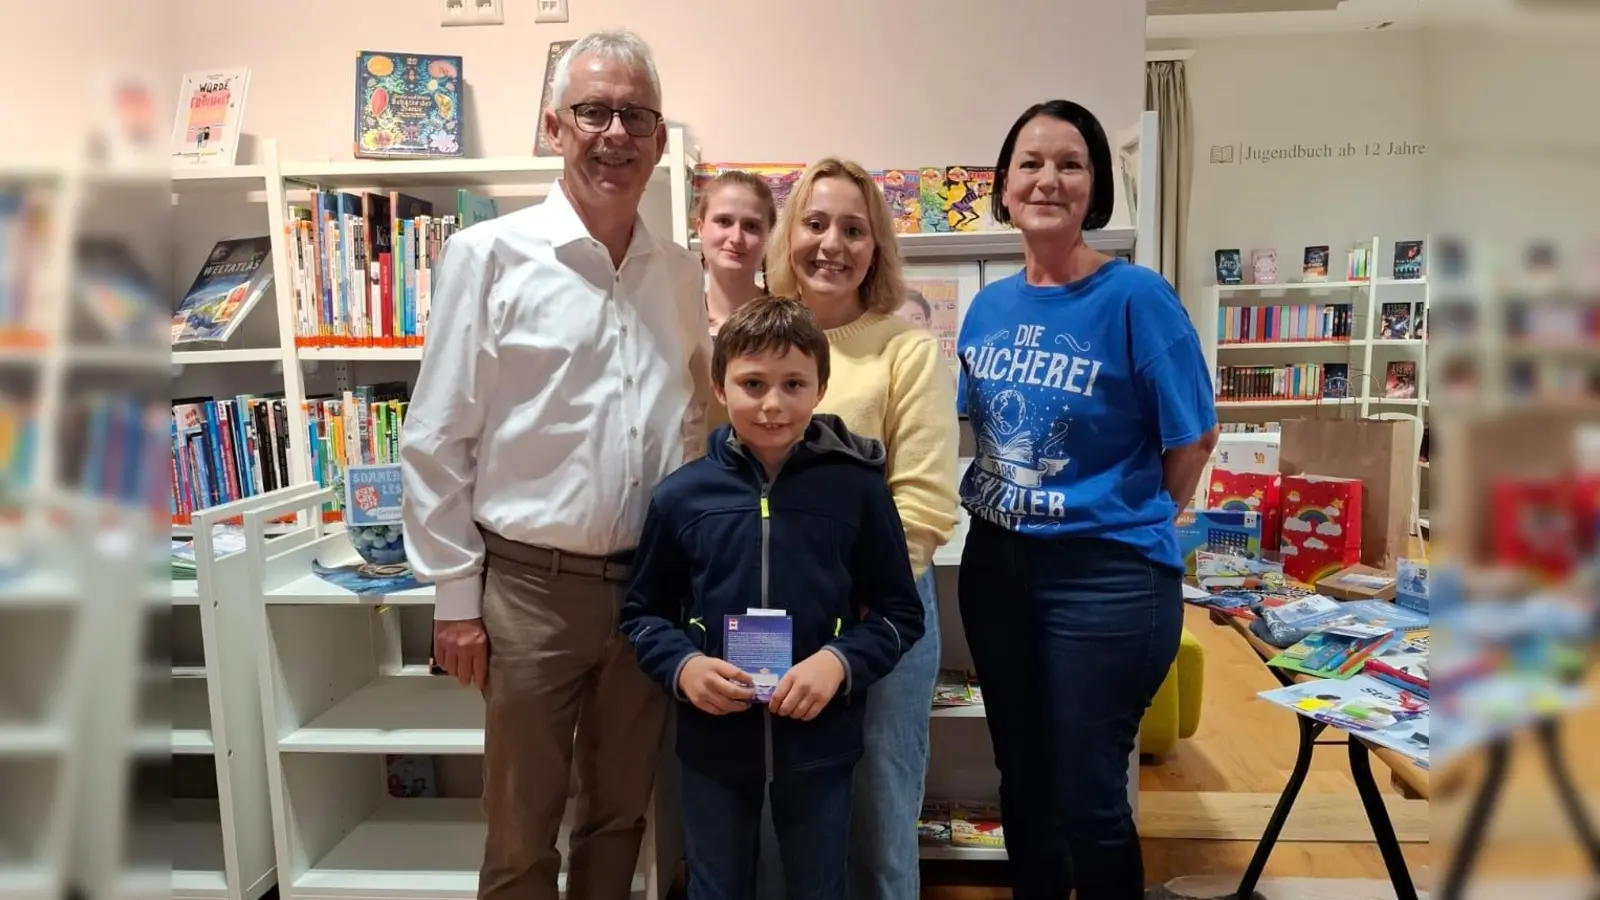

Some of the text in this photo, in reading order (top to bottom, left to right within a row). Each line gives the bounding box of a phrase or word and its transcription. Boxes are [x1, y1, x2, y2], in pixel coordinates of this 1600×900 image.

[1245, 141, 1426, 163] Jugendbuch ab 12 Jahre
[203, 261, 259, 277] WELTATLAS
[1013, 324, 1046, 348] DIE
[963, 342, 1103, 397] BÜCHEREI
[1001, 463, 1017, 481] DAS
